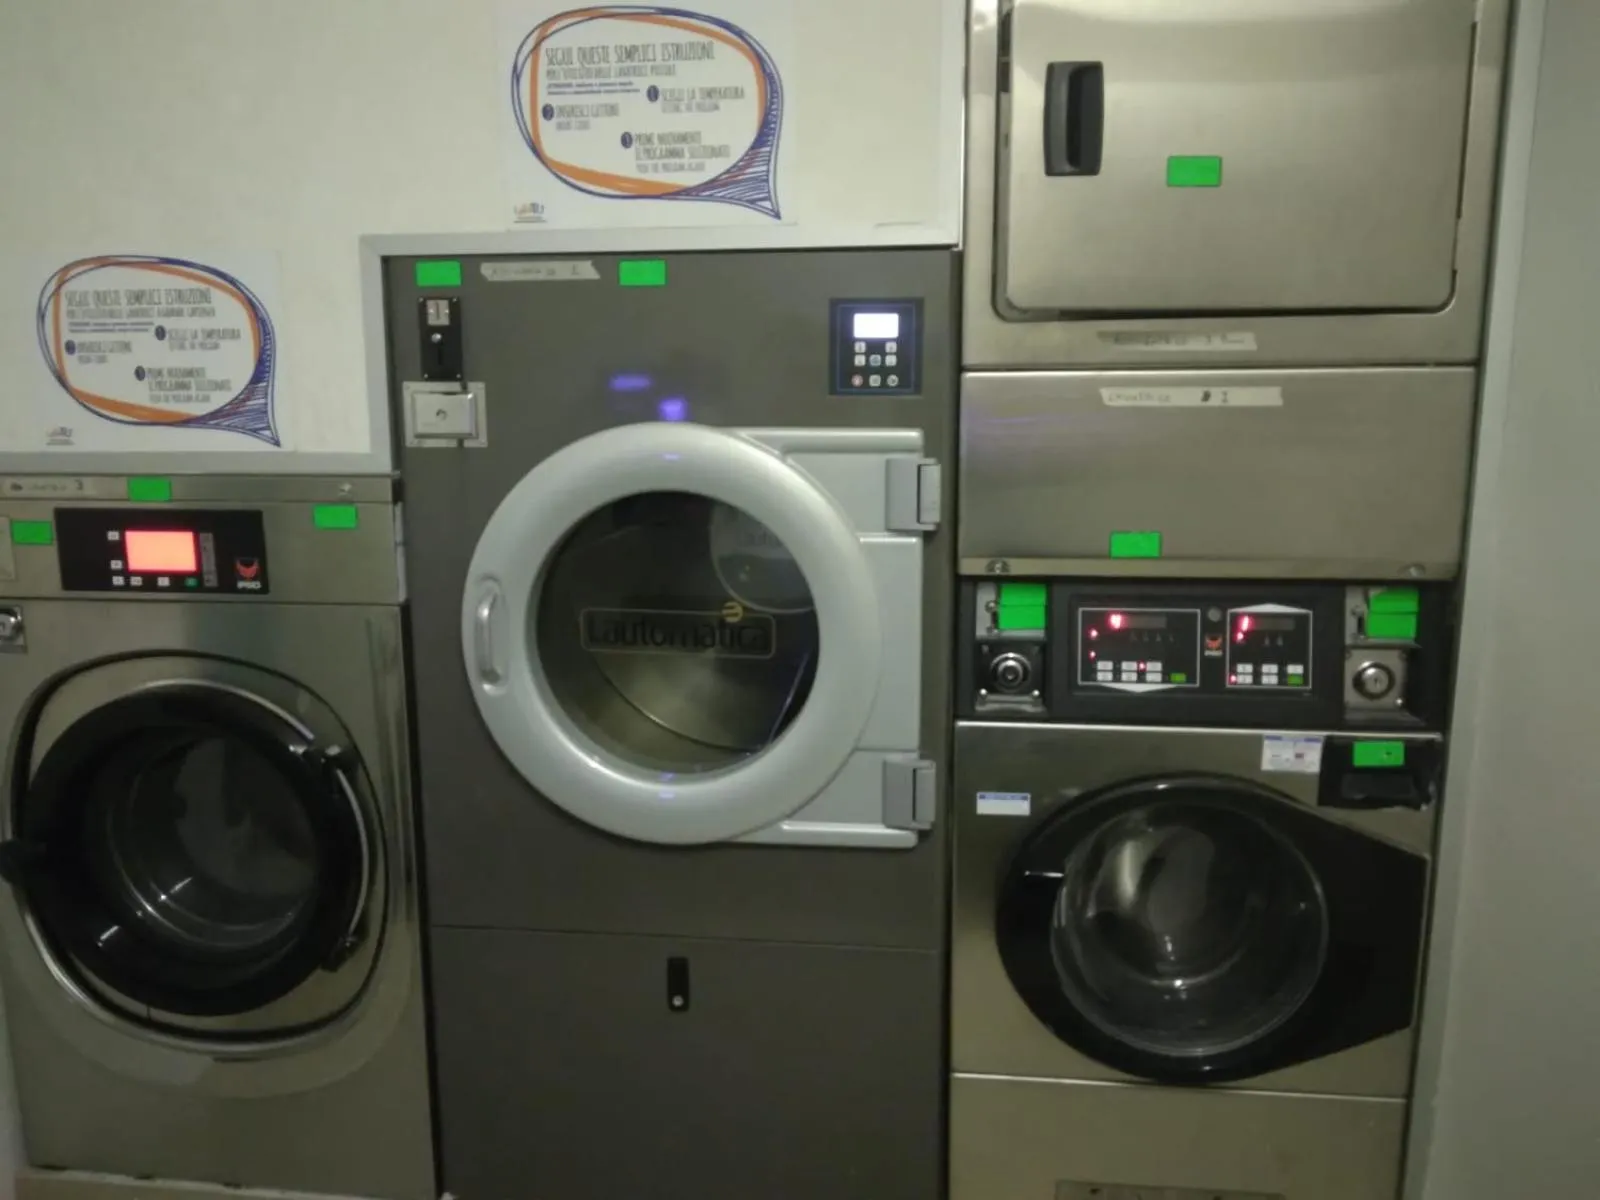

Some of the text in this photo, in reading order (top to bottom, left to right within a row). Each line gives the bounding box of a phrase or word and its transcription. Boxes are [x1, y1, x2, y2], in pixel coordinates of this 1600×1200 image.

[546, 40, 715, 68] SEGUI QUESTE SEMPLICI ISTRUZIONI
[699, 86, 744, 99] TEMPERATURA
[125, 289, 161, 305] SEMPLICI
